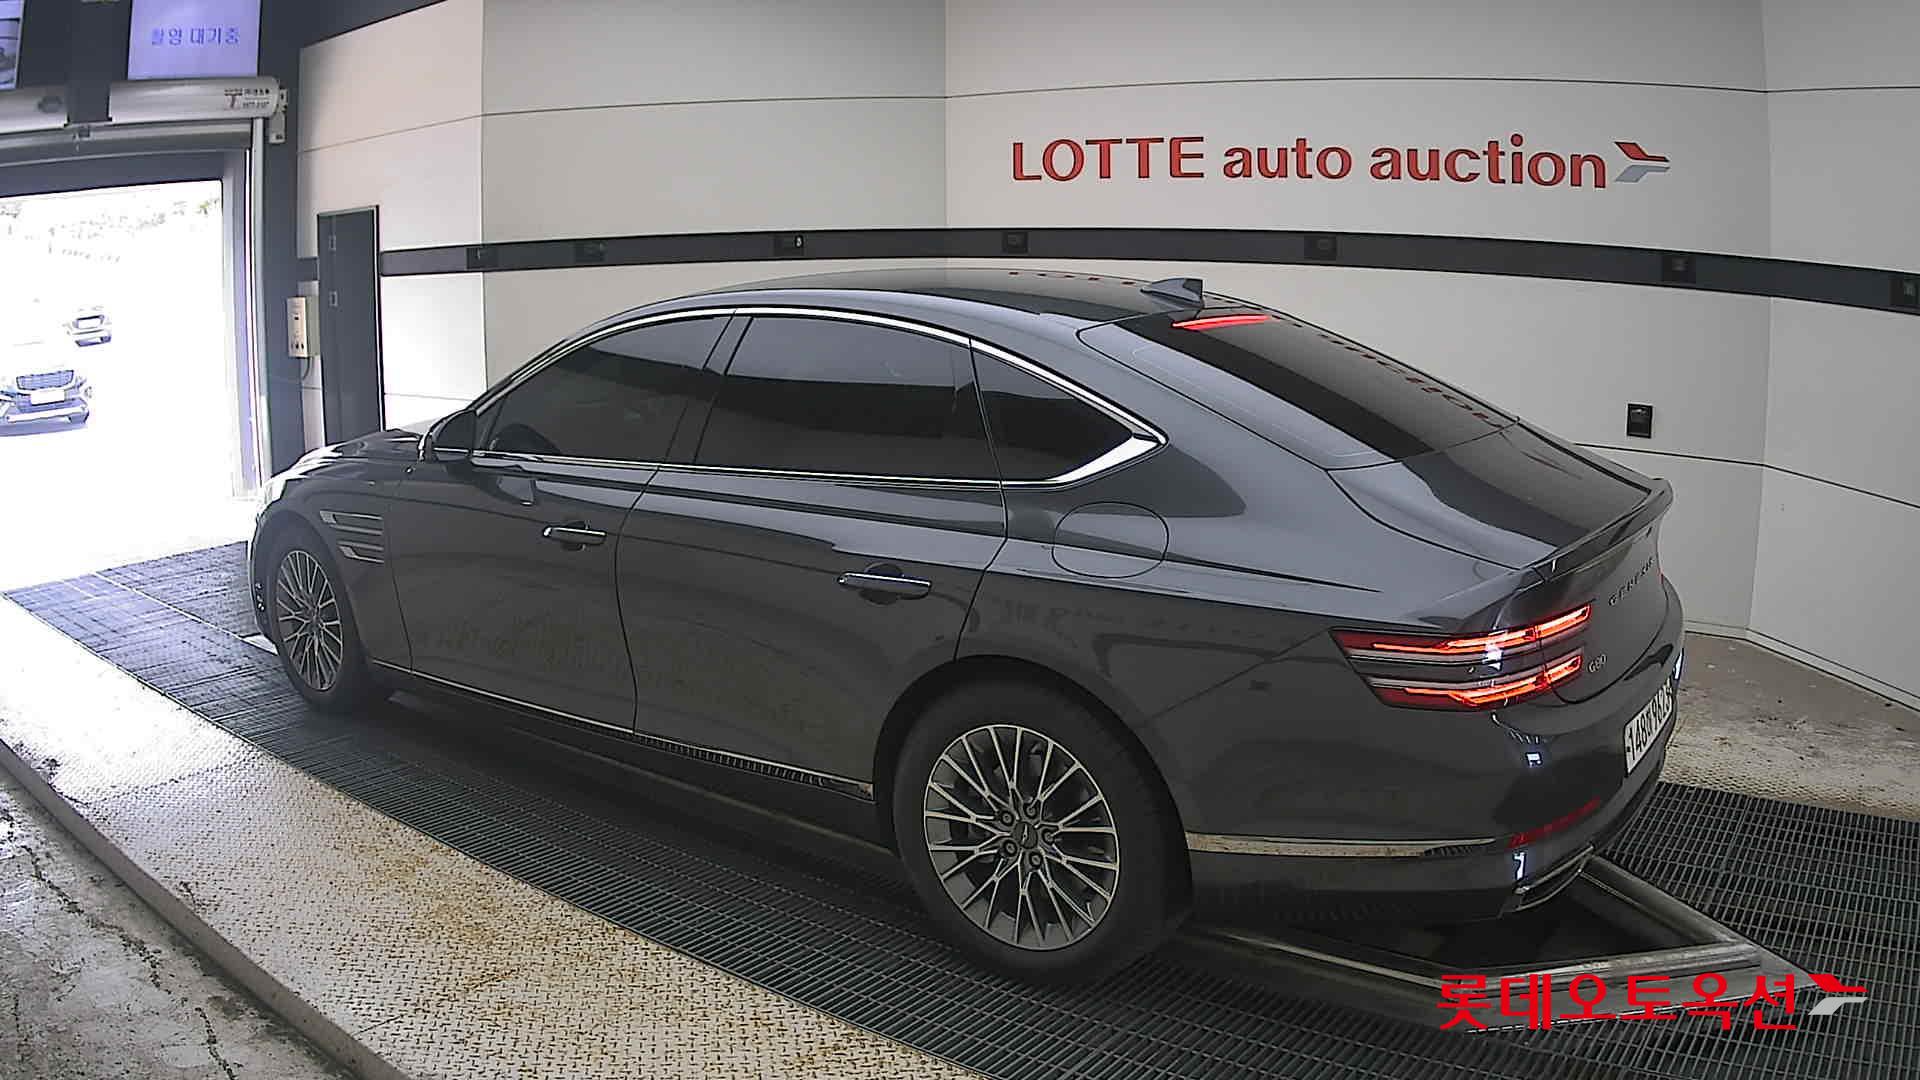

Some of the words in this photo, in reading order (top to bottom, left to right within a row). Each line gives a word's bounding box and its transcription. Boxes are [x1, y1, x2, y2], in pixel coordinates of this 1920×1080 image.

[190, 27, 240, 46] 대기중
[1013, 136, 1204, 182] LOTTE
[1223, 138, 1352, 180] auto
[1370, 133, 1606, 189] auction
